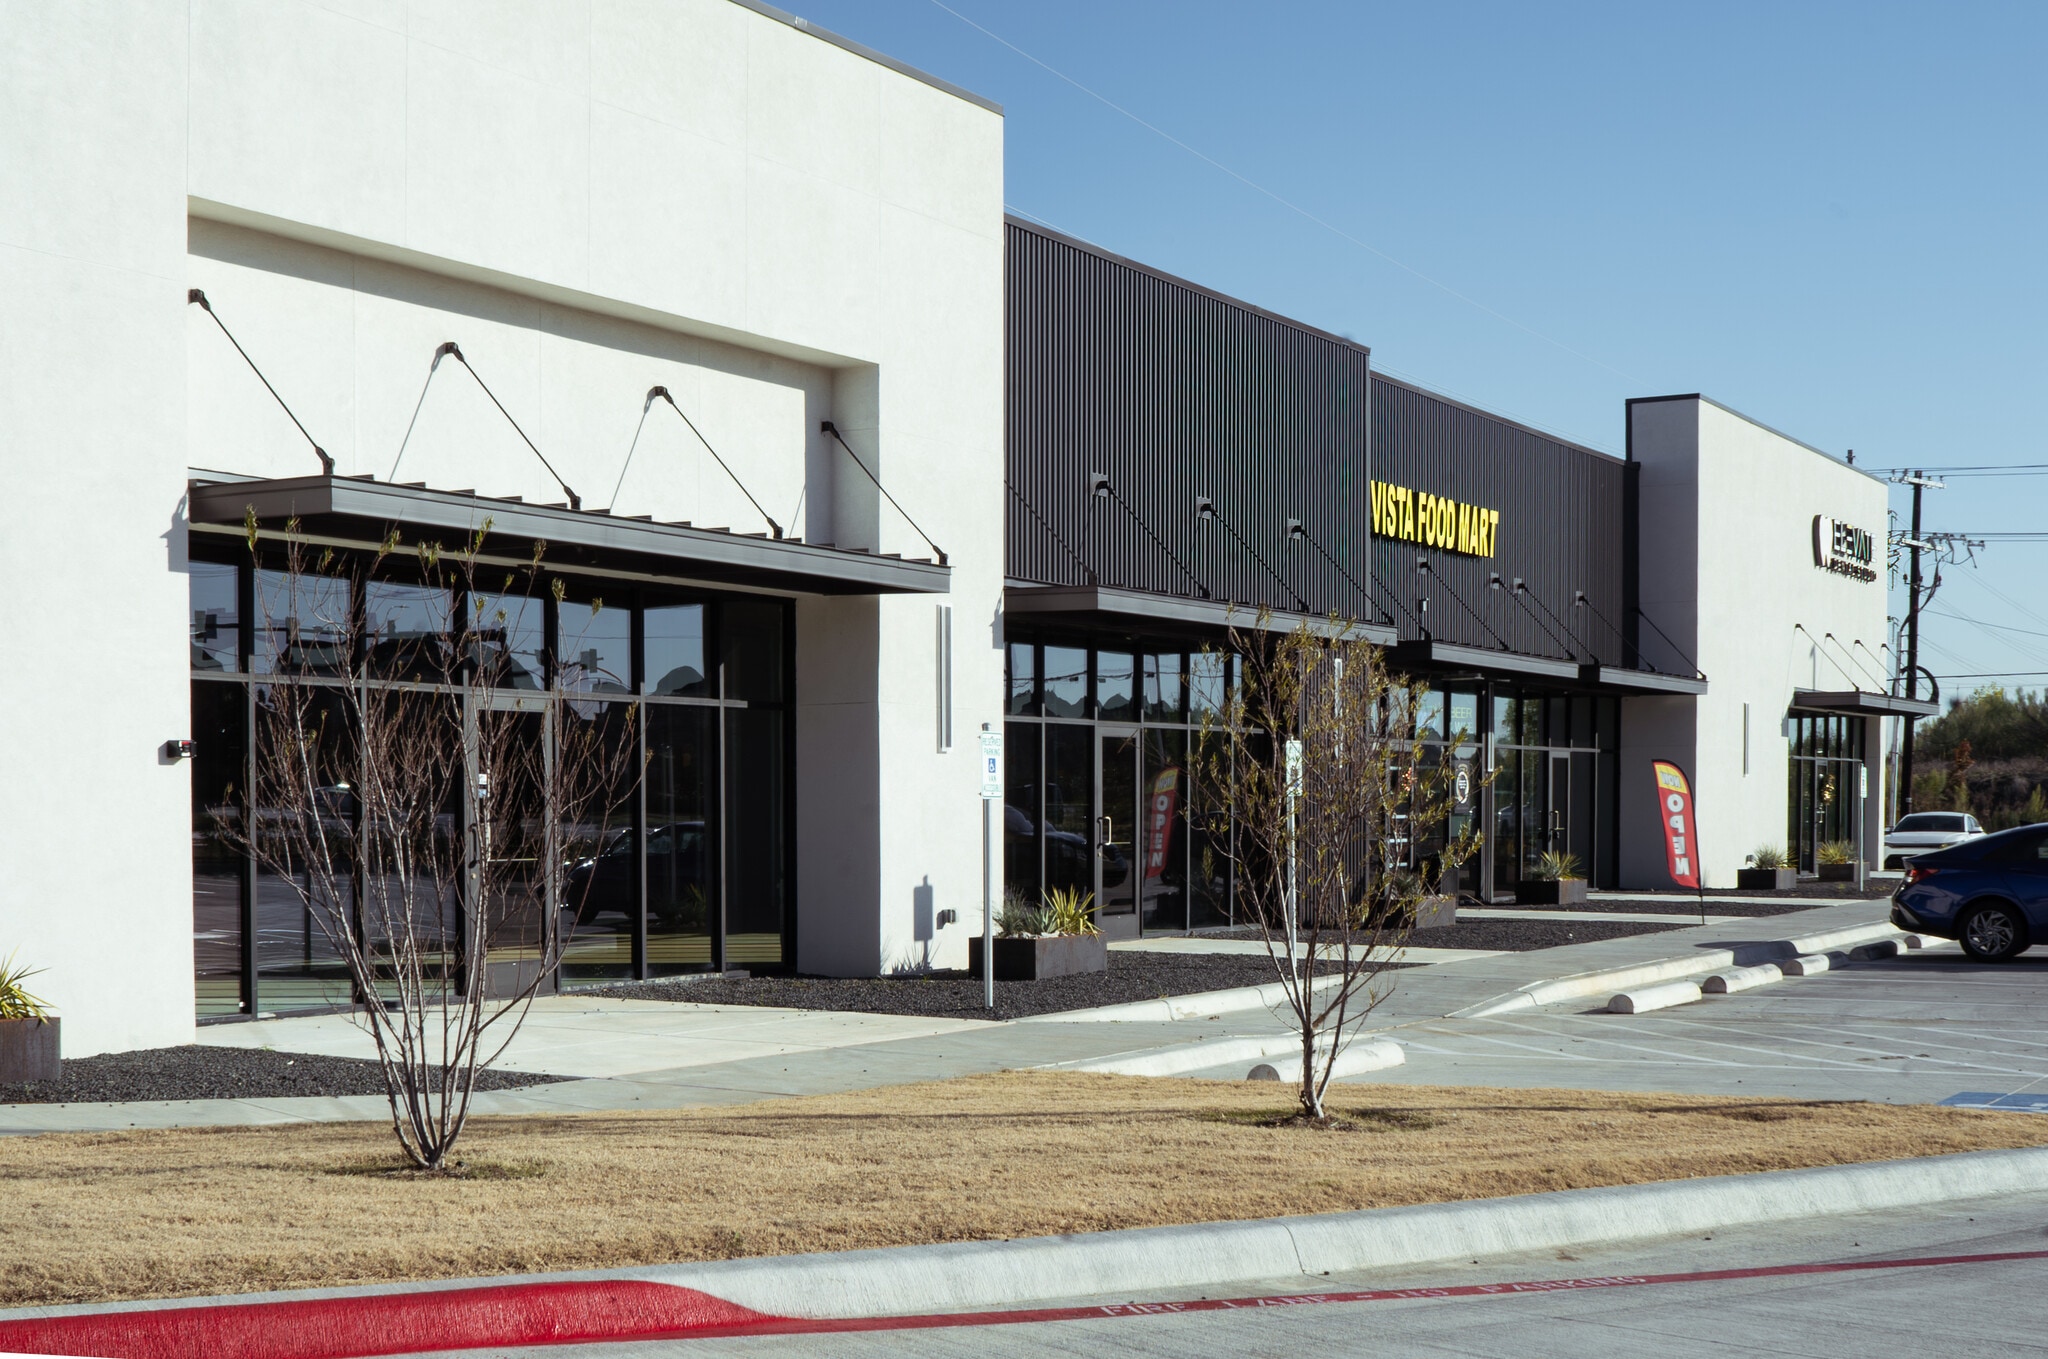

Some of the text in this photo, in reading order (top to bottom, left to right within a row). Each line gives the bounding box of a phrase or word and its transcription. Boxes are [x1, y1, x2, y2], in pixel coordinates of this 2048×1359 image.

[1370, 480, 1498, 558] VISTA FOOD MART
[1833, 518, 1877, 563] ELEVATE
[1151, 795, 1169, 868] OPEN
